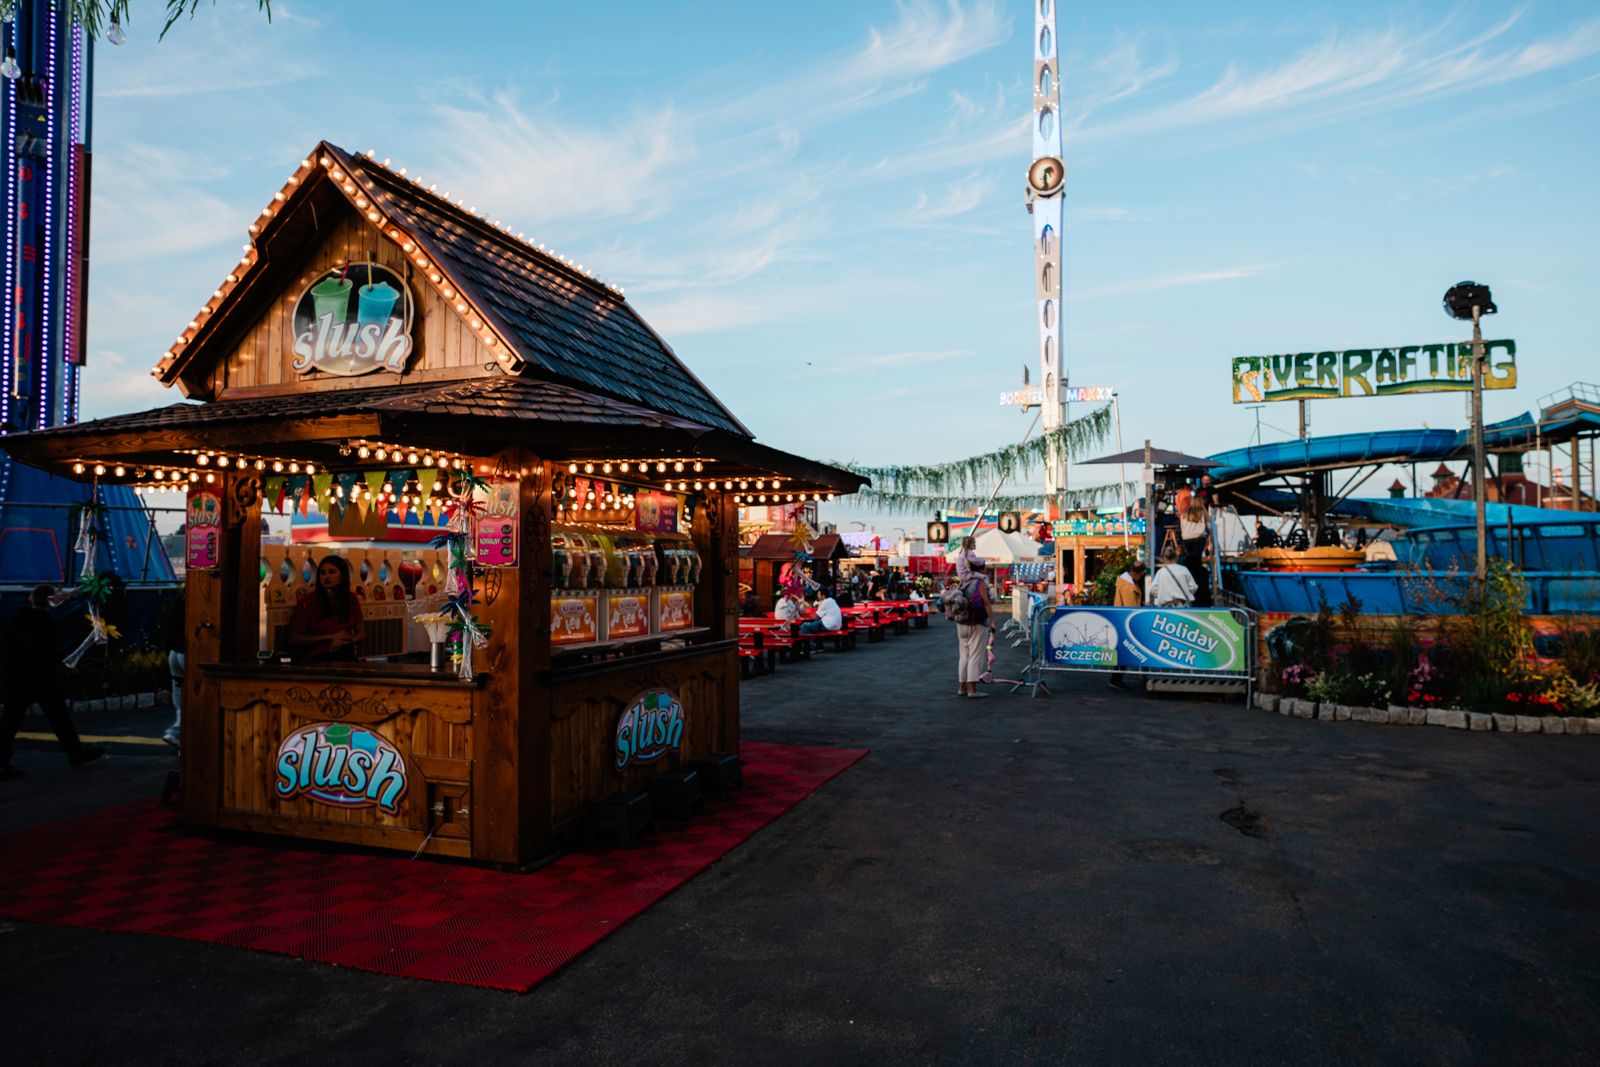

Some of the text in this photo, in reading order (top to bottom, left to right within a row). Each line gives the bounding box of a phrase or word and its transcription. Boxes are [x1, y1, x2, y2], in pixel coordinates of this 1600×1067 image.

[292, 312, 409, 369] slush
[1232, 339, 1517, 403] RIVER RAFTING
[1152, 613, 1219, 652] Holiday
[1208, 613, 1240, 642] welcome
[1054, 650, 1113, 662] SZCZECIN
[1122, 638, 1149, 664] witamy
[1157, 639, 1197, 666] Park
[616, 702, 684, 769] slush
[276, 731, 404, 810] slush
